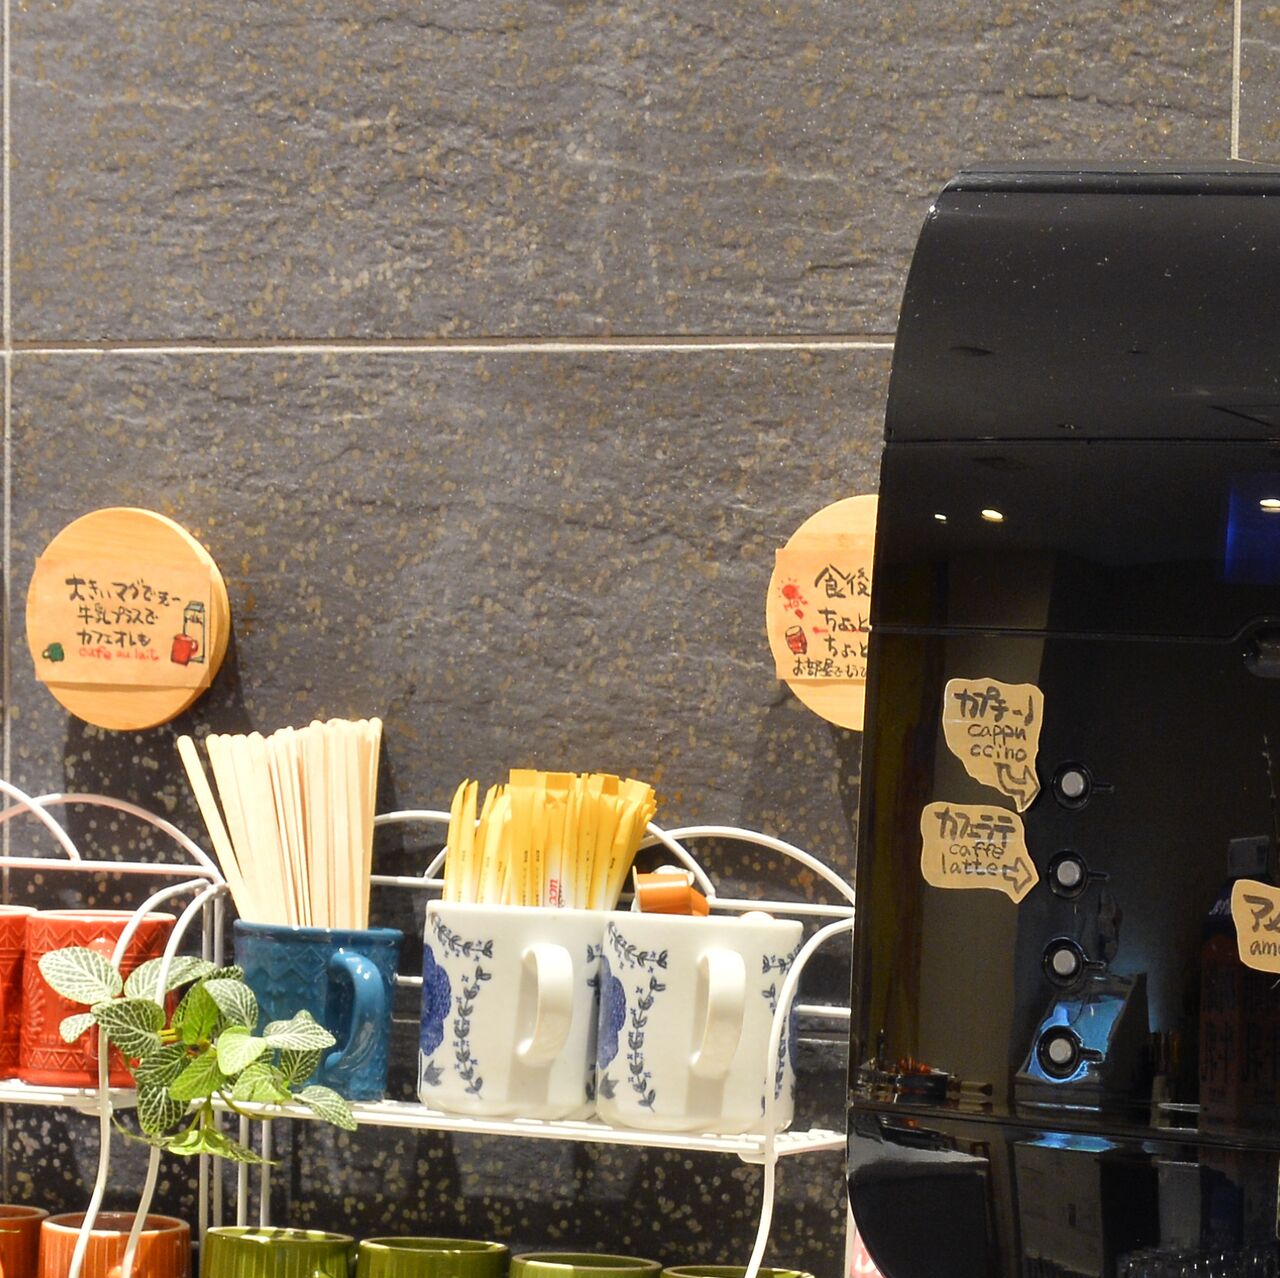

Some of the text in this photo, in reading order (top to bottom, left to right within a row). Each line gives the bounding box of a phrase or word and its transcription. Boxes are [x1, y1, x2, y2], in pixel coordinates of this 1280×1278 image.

[954, 686, 1034, 726] カプチーノ
[967, 722, 1026, 745] cappu
[970, 744, 1027, 762] ccino
[941, 853, 998, 876] latte
